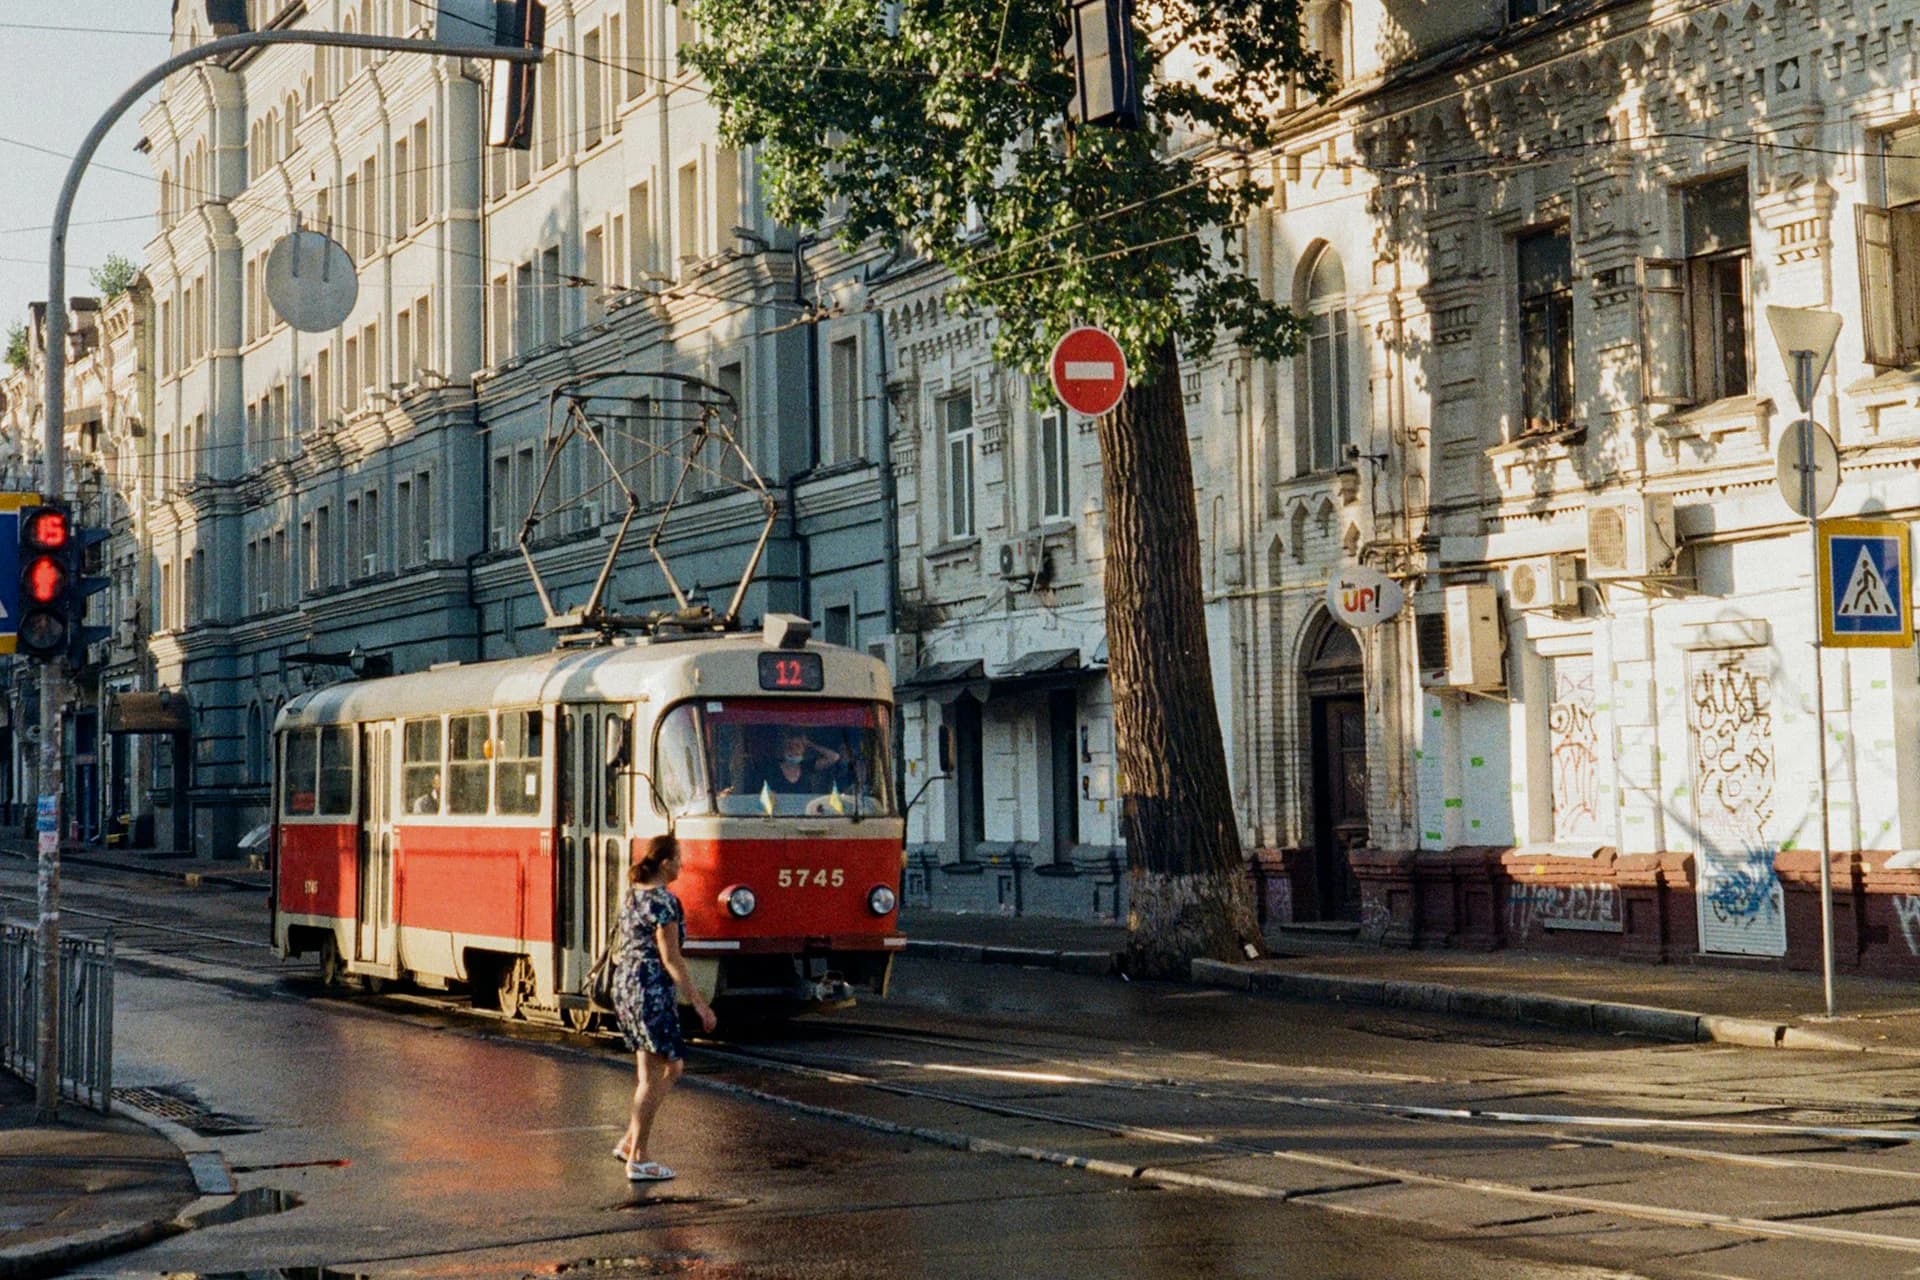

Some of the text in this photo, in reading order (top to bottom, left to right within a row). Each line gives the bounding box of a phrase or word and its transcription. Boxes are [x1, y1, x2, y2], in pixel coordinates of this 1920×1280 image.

[1344, 584, 1381, 613] UP!
[776, 660, 801, 686] 12
[778, 869, 844, 888] 5745
